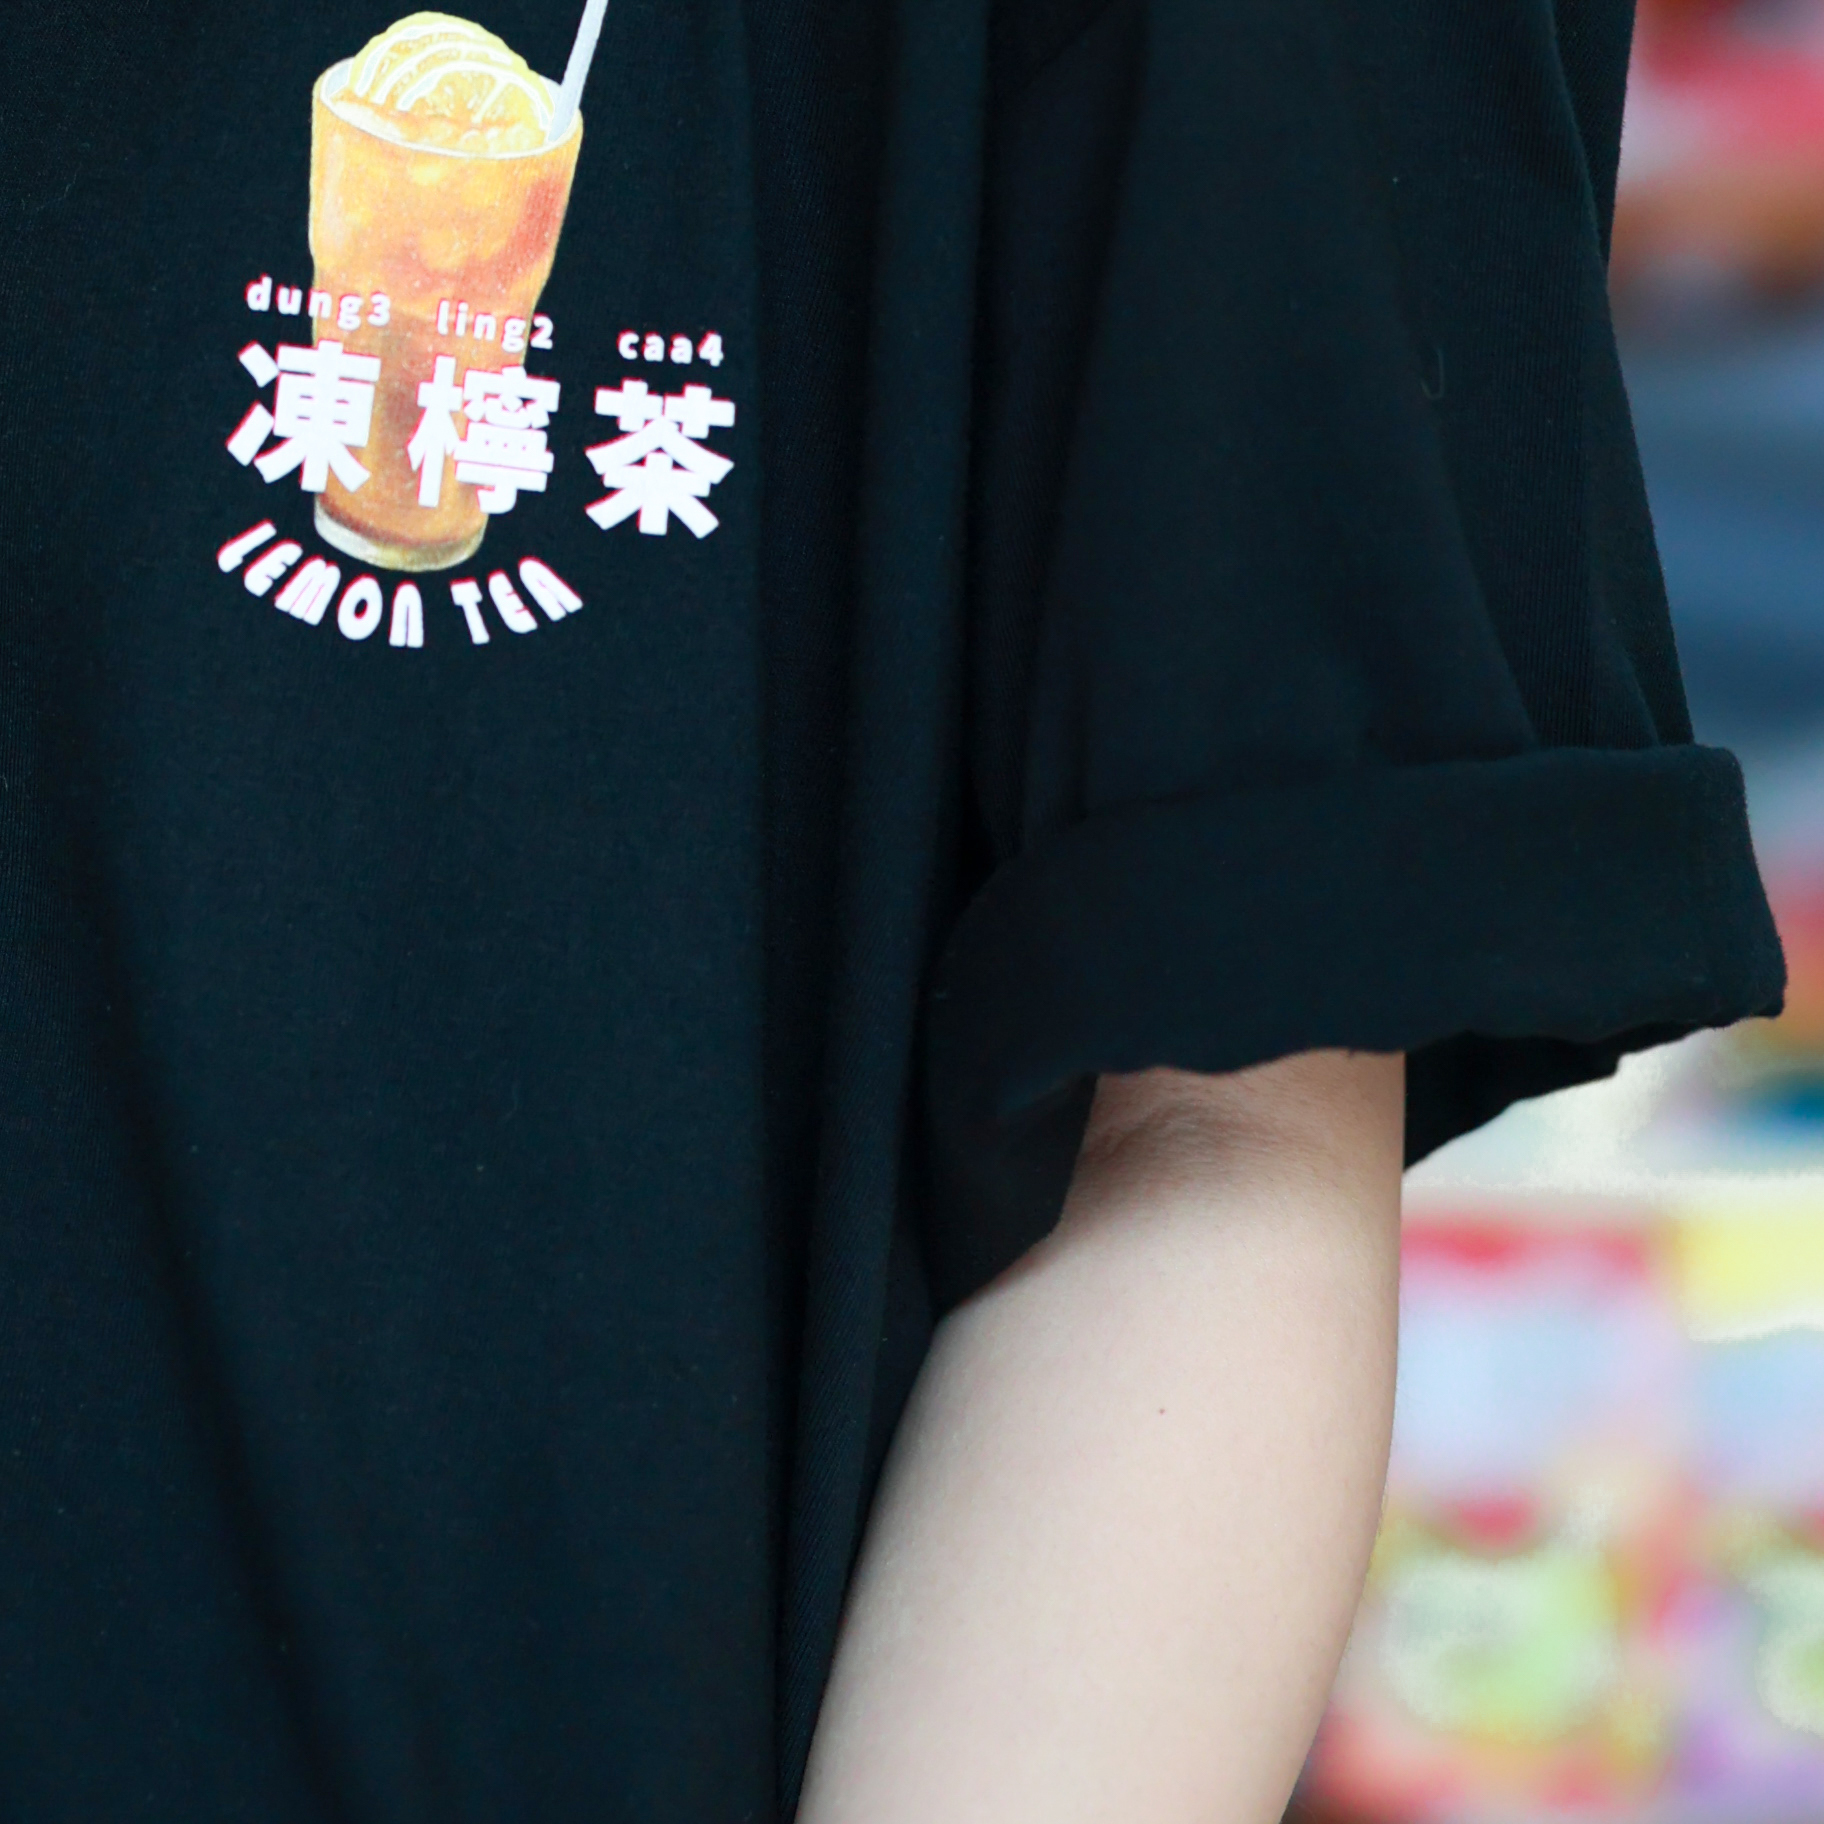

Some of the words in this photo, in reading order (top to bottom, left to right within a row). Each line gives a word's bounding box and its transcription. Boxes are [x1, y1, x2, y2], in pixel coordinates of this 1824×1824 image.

[245, 274, 392, 332] dung3
[436, 299, 555, 354] ling2
[617, 331, 725, 367] caa4
[226, 338, 736, 539] 凍檸茶
[216, 520, 425, 648] LEMON
[450, 556, 584, 645] TEA
